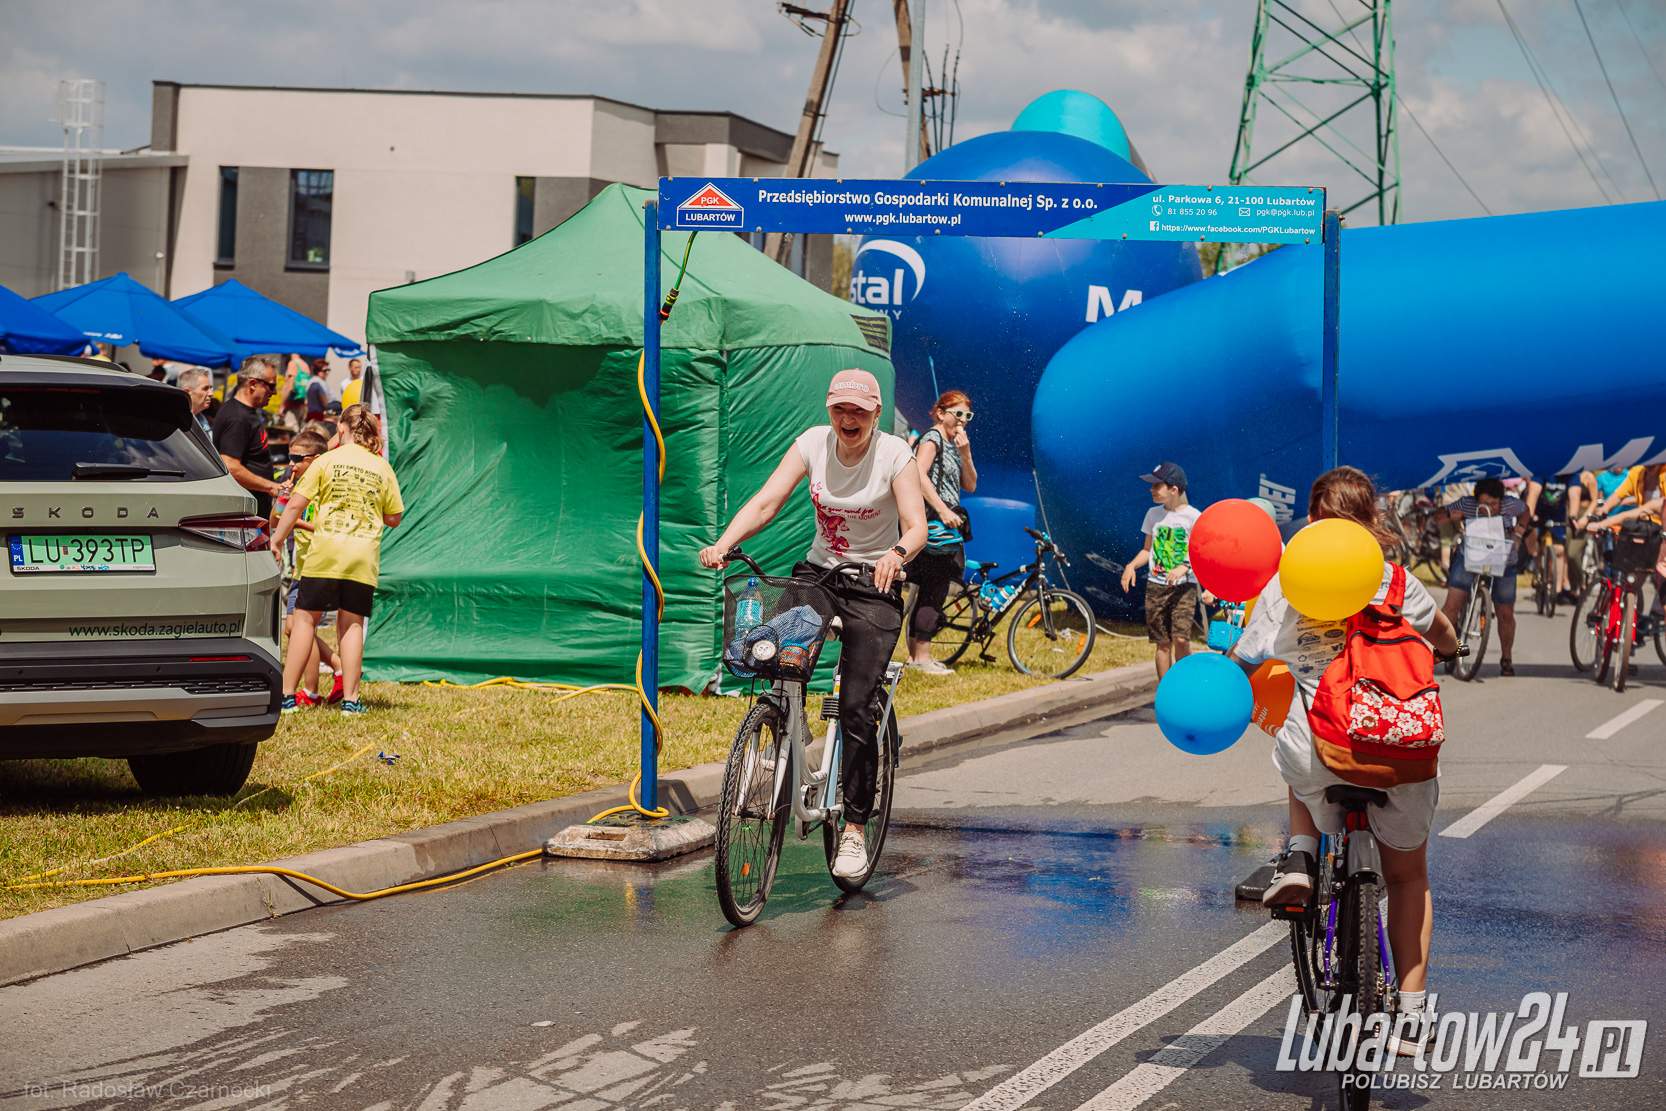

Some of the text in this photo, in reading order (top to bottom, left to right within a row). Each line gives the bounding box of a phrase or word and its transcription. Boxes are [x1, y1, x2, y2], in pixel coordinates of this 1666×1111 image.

[700, 196, 720, 205] PGK
[758, 189, 1098, 211] Przedsiębiorstwo Gospodarki Komunalnej Sp. z o.o.
[1152, 195, 1316, 206] ul. Parkowa 6, 21-100 Lubartów
[685, 211, 736, 222] LUBARTÓW
[1167, 207, 1177, 215] 81
[1196, 208, 1206, 216] 20
[1207, 208, 1217, 216] 96
[1256, 208, 1315, 217] pgk@pgk.lub.pl
[844, 212, 962, 227] www.pgk.lubartow.pl
[1161, 223, 1316, 235] https://www.facebook.com/PGKLubartow
[28, 538, 145, 563] LU 393TP
[13, 554, 23, 562] PL
[68, 620, 242, 638] www.skoda.zagielauto.pl
